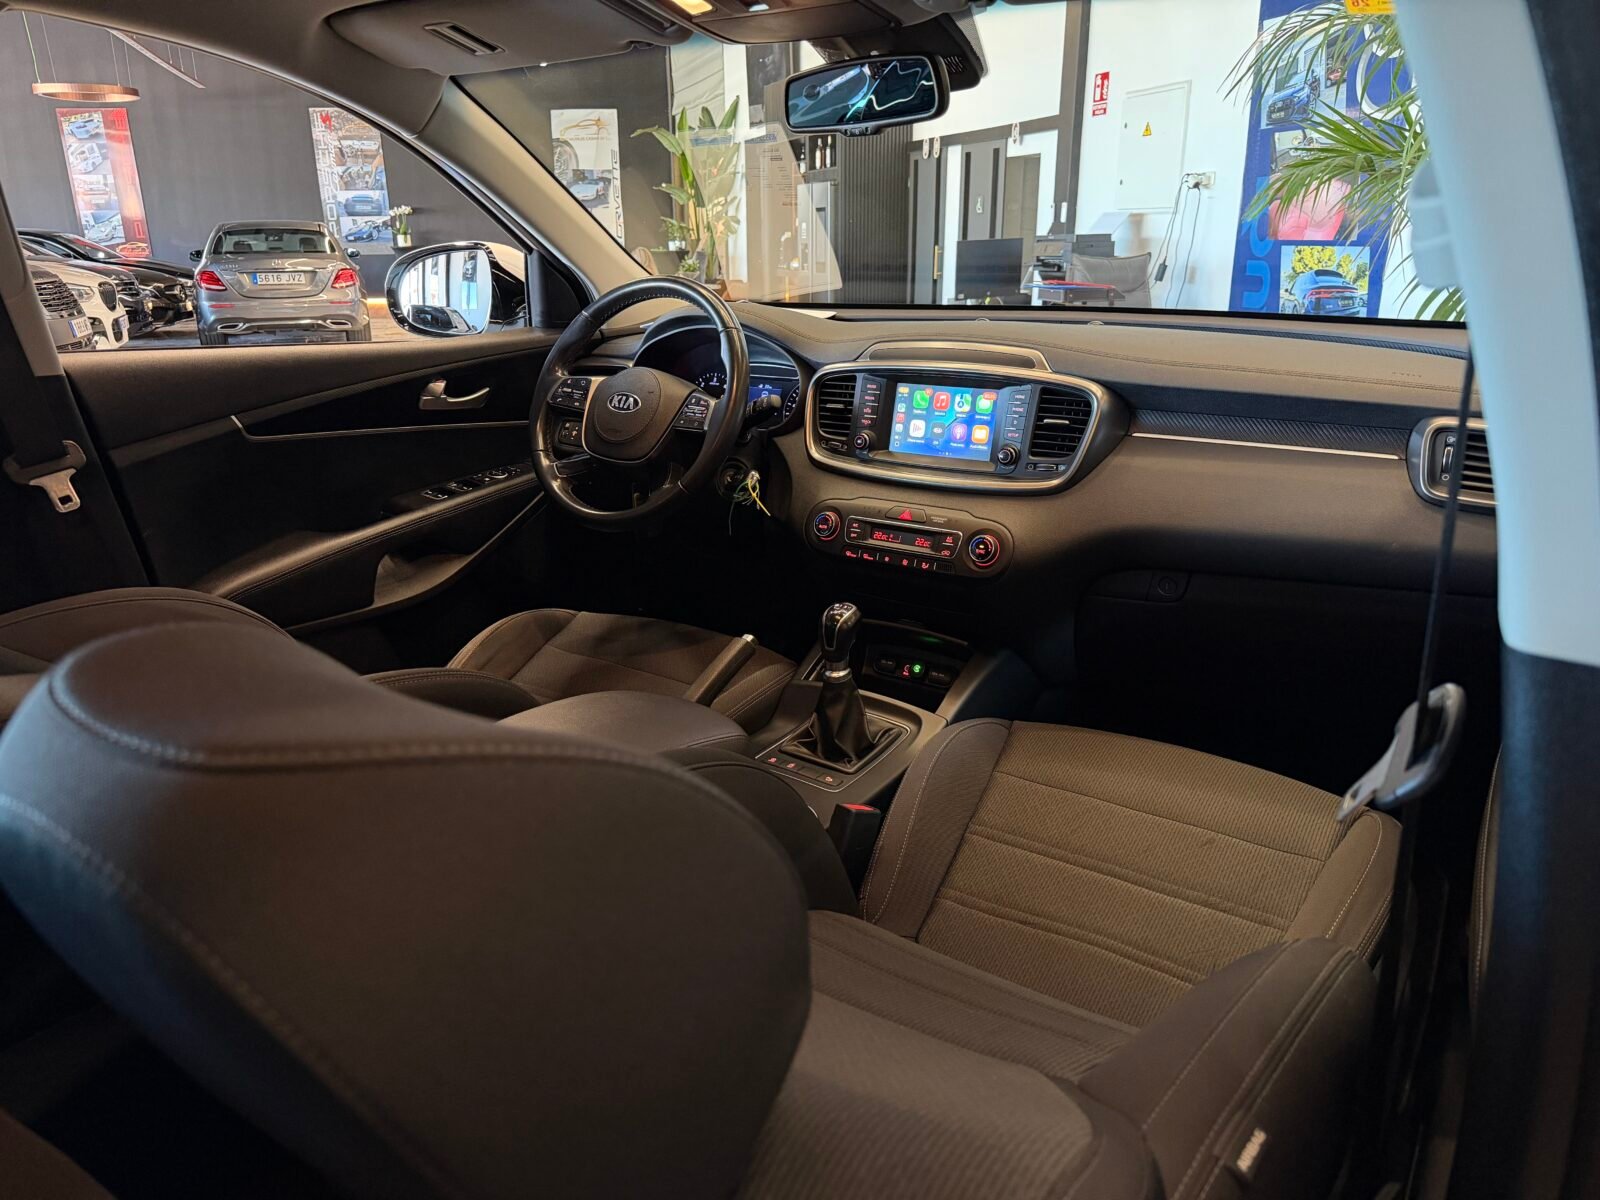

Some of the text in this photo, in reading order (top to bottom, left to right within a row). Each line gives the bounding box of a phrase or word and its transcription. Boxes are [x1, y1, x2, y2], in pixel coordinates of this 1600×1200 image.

[610, 148, 623, 239] ORVETTE
[258, 273, 303, 283] 5616 JVZ
[611, 394, 634, 410] KIA
